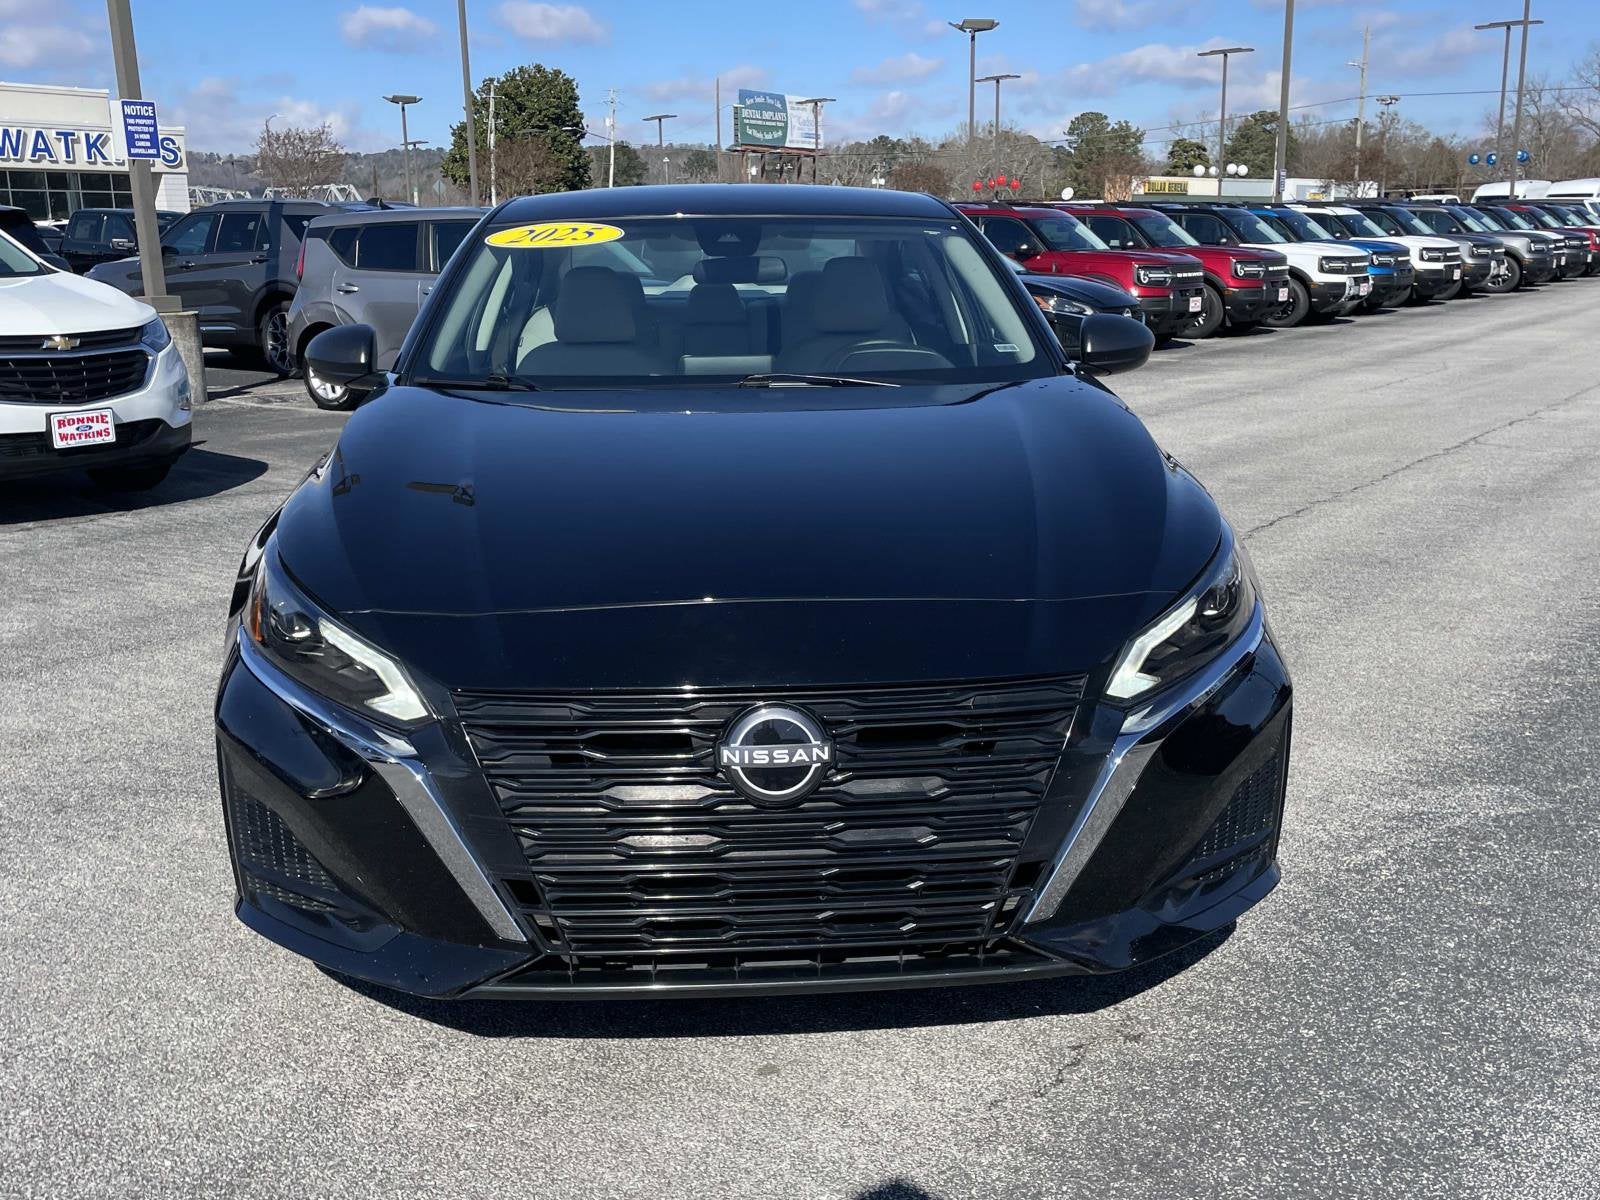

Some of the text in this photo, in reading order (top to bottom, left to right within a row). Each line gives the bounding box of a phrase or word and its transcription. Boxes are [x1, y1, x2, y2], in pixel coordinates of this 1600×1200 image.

[124, 105, 154, 116] NOTICE
[742, 109, 787, 121] DENTAL IMPLANTS
[0, 128, 181, 165] WATKS
[1147, 181, 1188, 192] DOLLAR GENERAL
[506, 227, 603, 244] 2025
[57, 414, 109, 429] RONNIE
[58, 428, 111, 442] WATKINS
[723, 746, 829, 764] NISSAN
